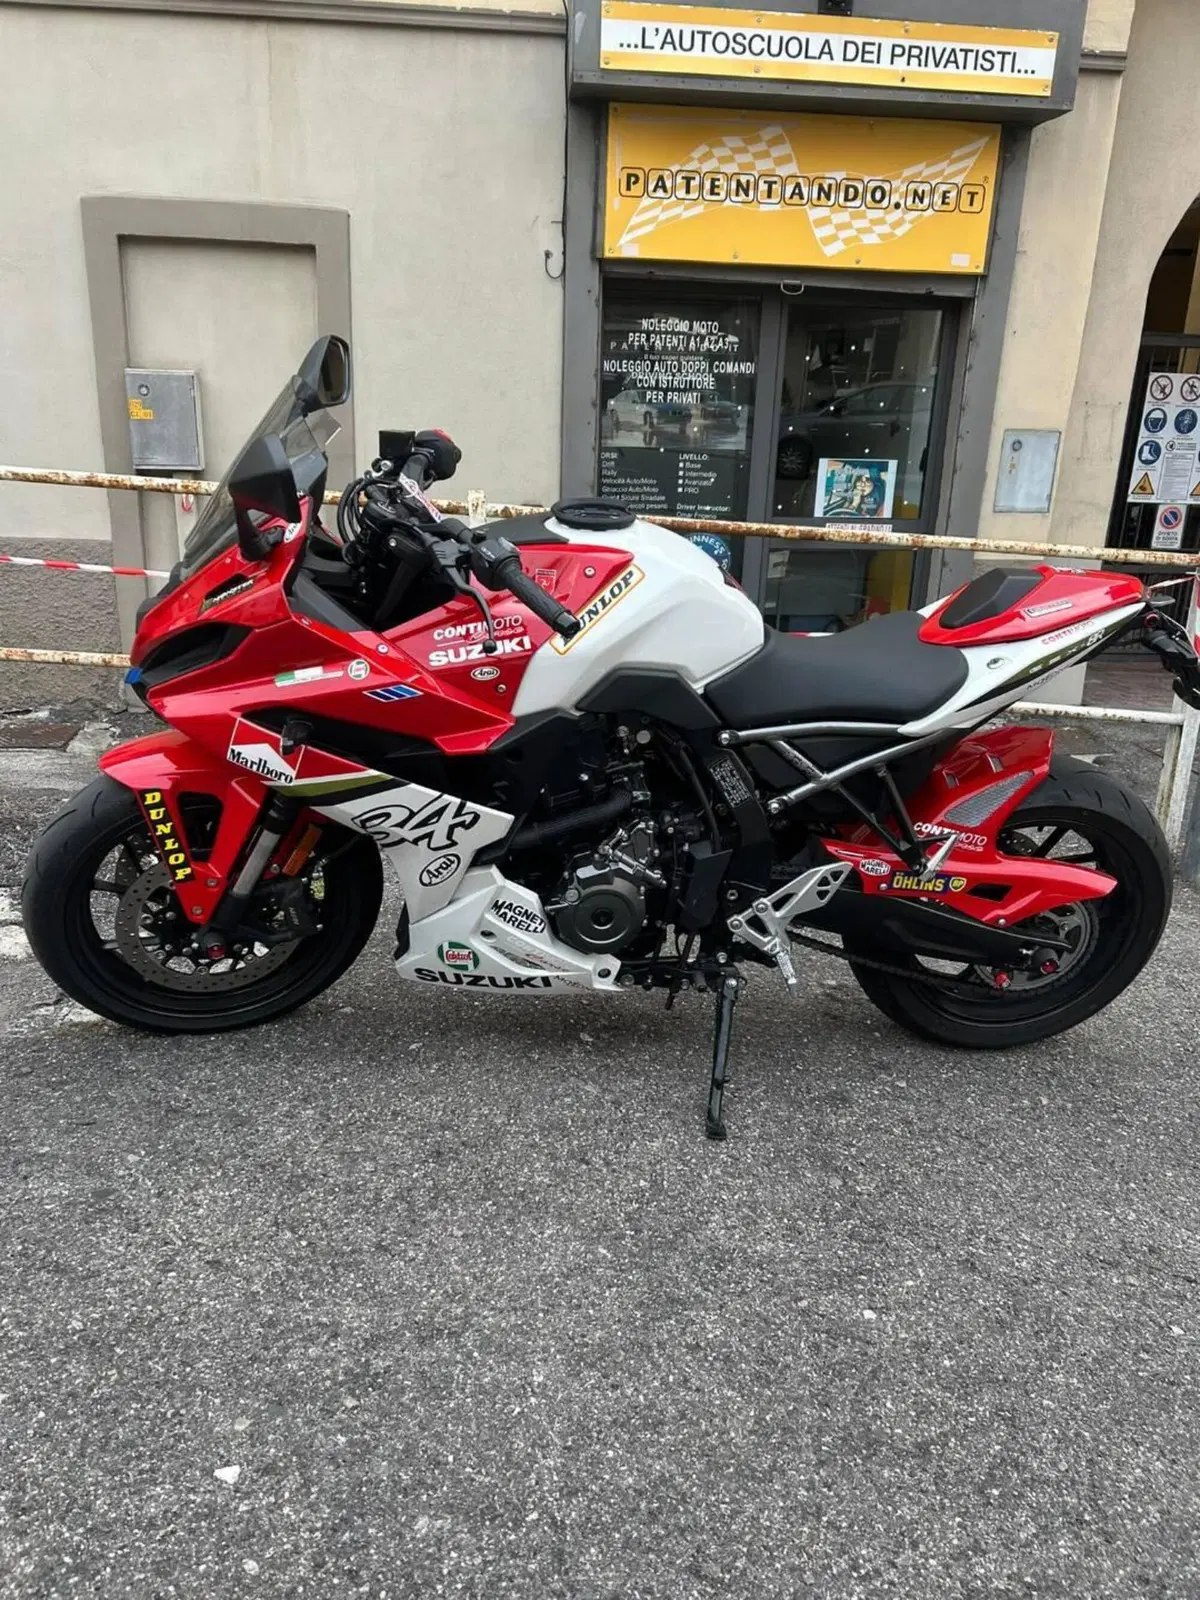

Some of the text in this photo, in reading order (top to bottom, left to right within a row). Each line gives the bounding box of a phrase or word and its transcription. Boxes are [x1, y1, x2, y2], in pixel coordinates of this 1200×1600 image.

[842, 40, 882, 64] DEI
[890, 44, 1036, 75] PRIVATISTI...
[620, 168, 985, 212] PATENTANDO.NET
[642, 318, 719, 334] NOLEGGIO MOTO
[628, 332, 647, 345] PER
[650, 334, 687, 348] PATENTI
[603, 359, 755, 375] NOLEGGIO AUTO DOPPI COMANDI
[637, 376, 716, 390] CON ISTRUTTORE
[646, 391, 701, 405] PER PRIVATI
[560, 570, 634, 648] UNLOP
[428, 636, 532, 667] SUZUKI
[228, 746, 293, 785] Marlboro
[144, 791, 191, 880] DUNLOP
[426, 856, 455, 885] Arai
[892, 871, 945, 892] ÖHLINS
[952, 880, 963, 888] BP
[445, 949, 472, 963] Castrol
[413, 967, 553, 989] SUZUKI
